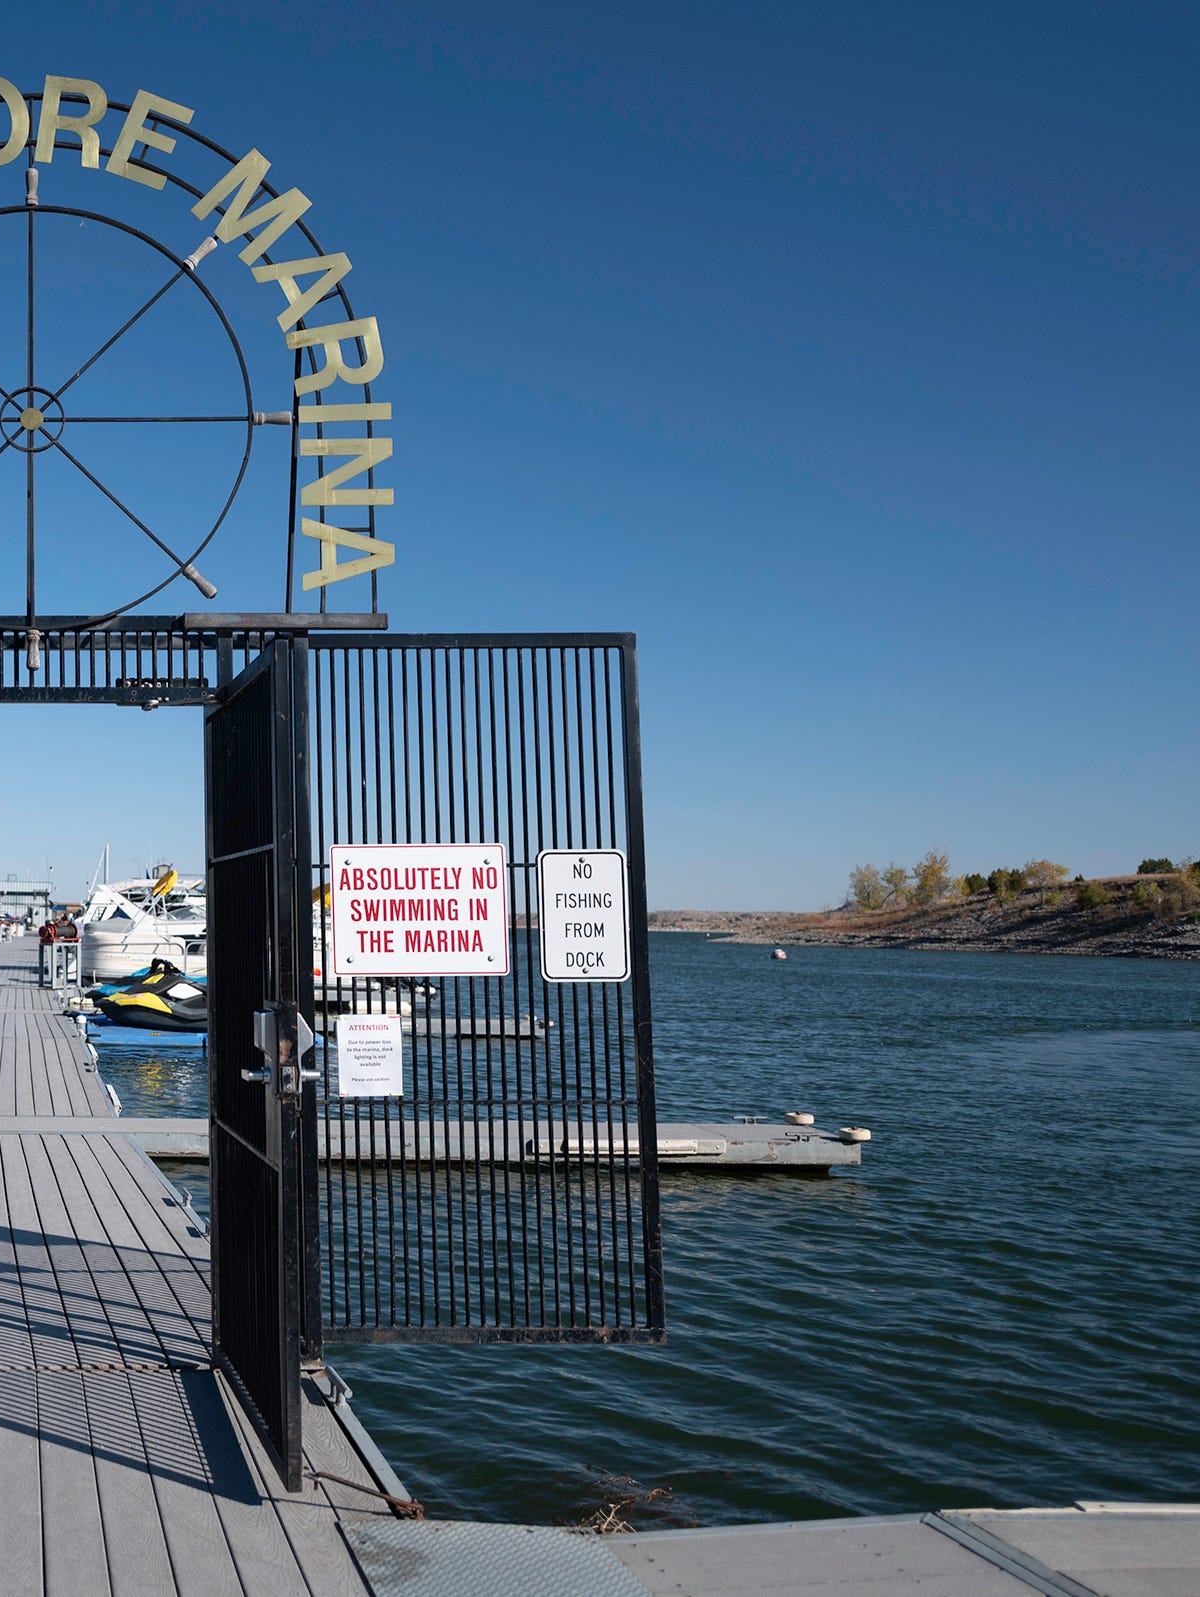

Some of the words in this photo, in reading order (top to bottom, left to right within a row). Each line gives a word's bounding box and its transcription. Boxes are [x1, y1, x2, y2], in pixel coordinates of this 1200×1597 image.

[190, 148, 396, 590] MARINA
[339, 867, 462, 891] ABSOLUTELY
[472, 866, 498, 890] NO
[572, 864, 592, 879] NO
[350, 898, 459, 922] SWIMMING
[469, 898, 488, 921] IN
[555, 893, 612, 909] FISHING
[565, 923, 605, 938] FROM
[356, 930, 394, 953] THE
[405, 930, 483, 952] MARINA
[566, 952, 605, 968] DOCK
